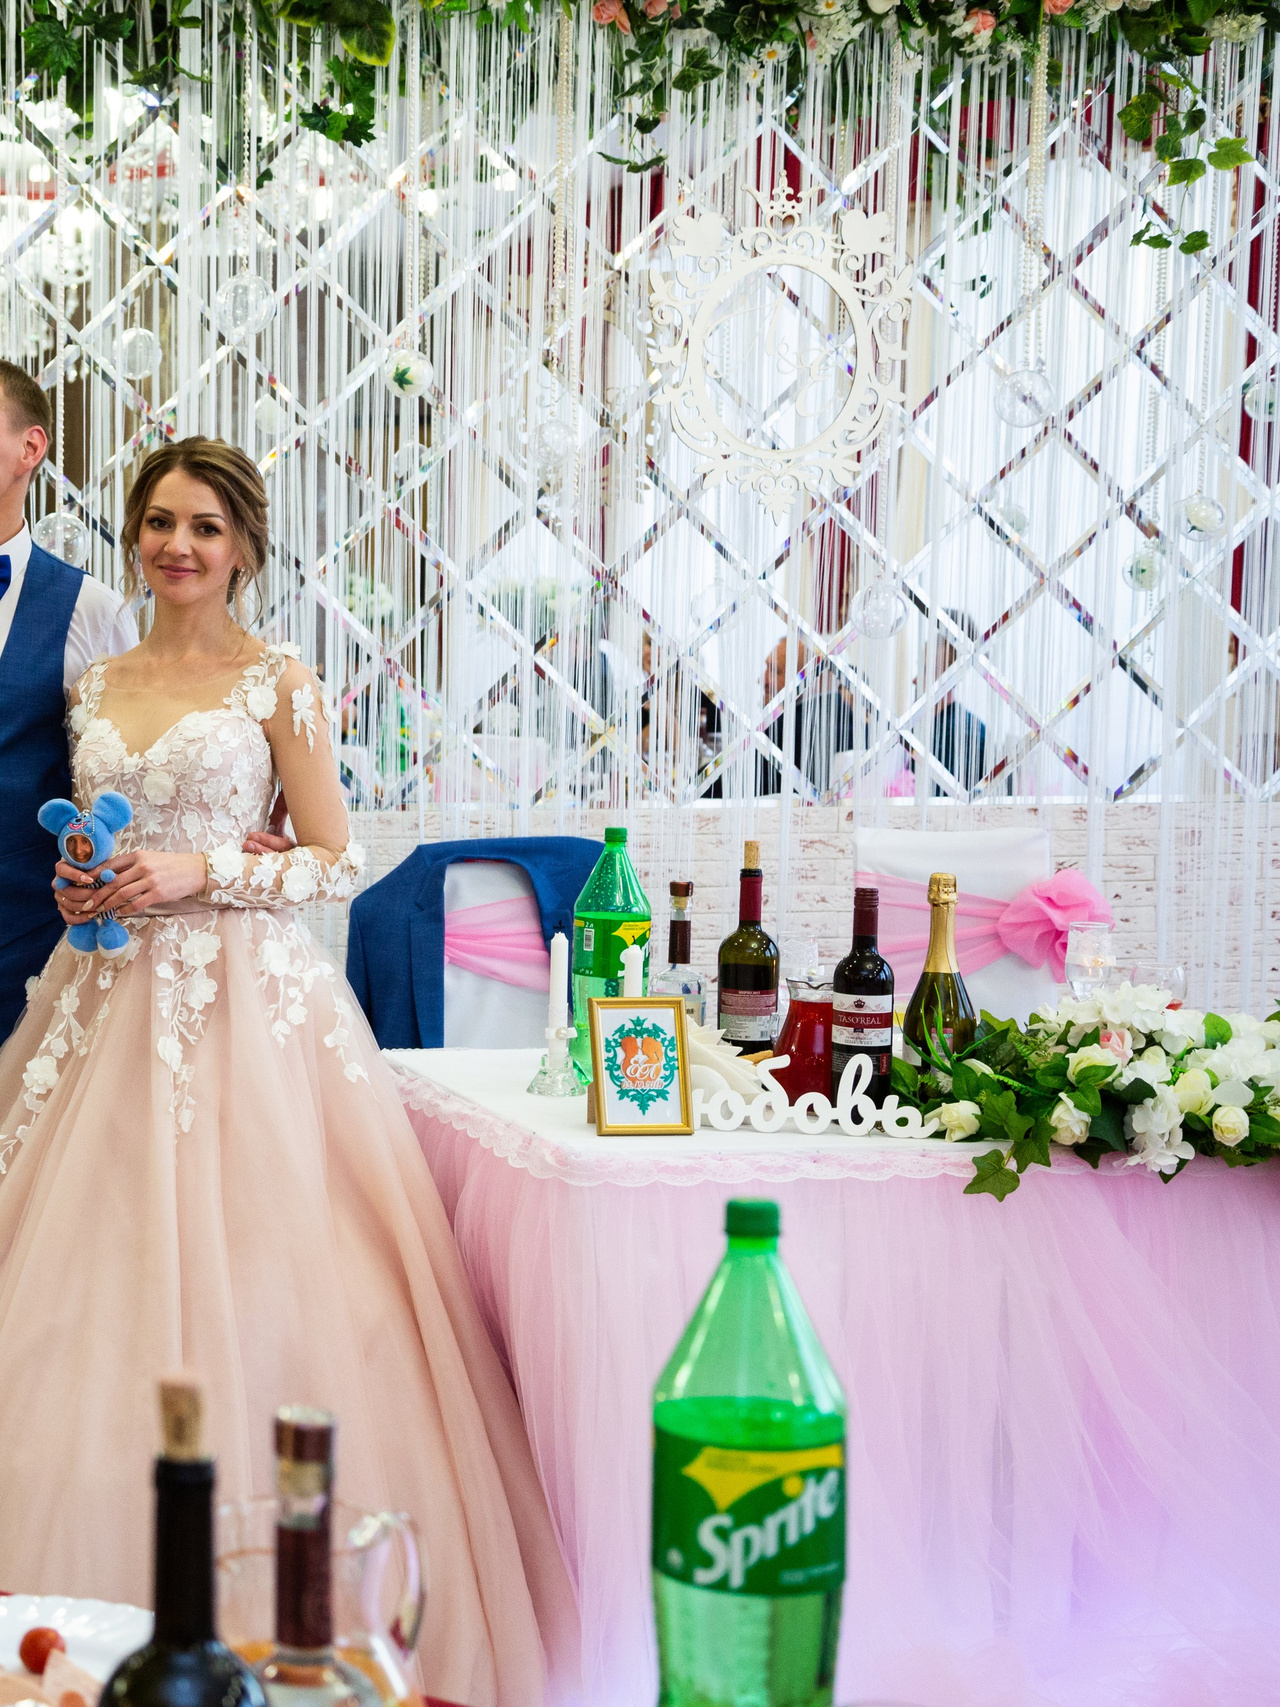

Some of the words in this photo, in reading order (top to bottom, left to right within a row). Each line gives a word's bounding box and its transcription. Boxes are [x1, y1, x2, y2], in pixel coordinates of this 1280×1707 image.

[838, 1014, 859, 1024] TASO
[860, 1016, 882, 1025] REAL
[693, 1053, 940, 1138] юбовь
[693, 1470, 839, 1588] Sprite
